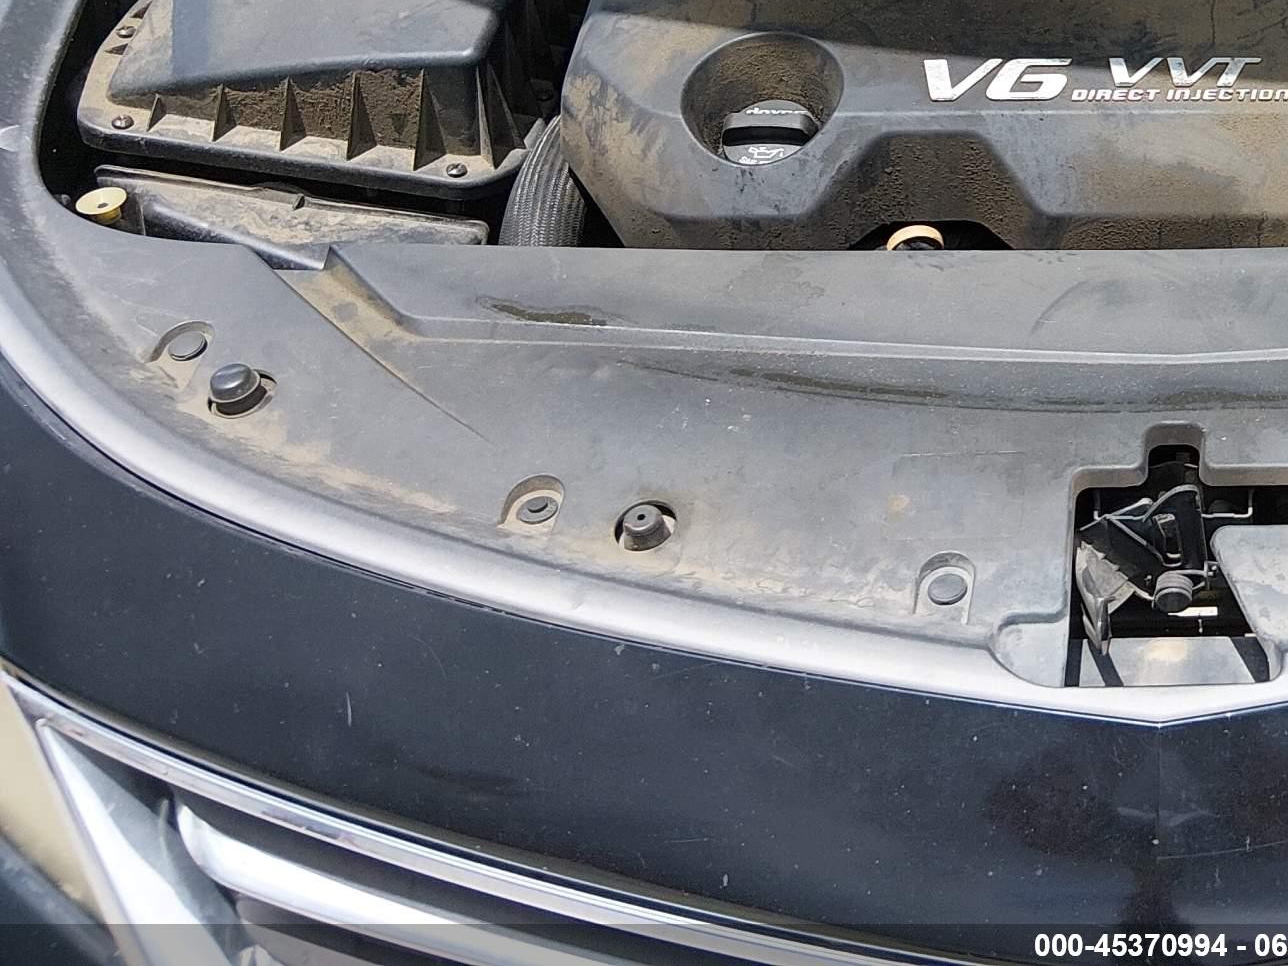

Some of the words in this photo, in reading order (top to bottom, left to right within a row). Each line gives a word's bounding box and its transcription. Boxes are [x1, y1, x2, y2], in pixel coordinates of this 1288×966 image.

[922, 57, 1073, 102] V6
[1108, 56, 1263, 88] VVT
[1071, 88, 1161, 102] DIRECT
